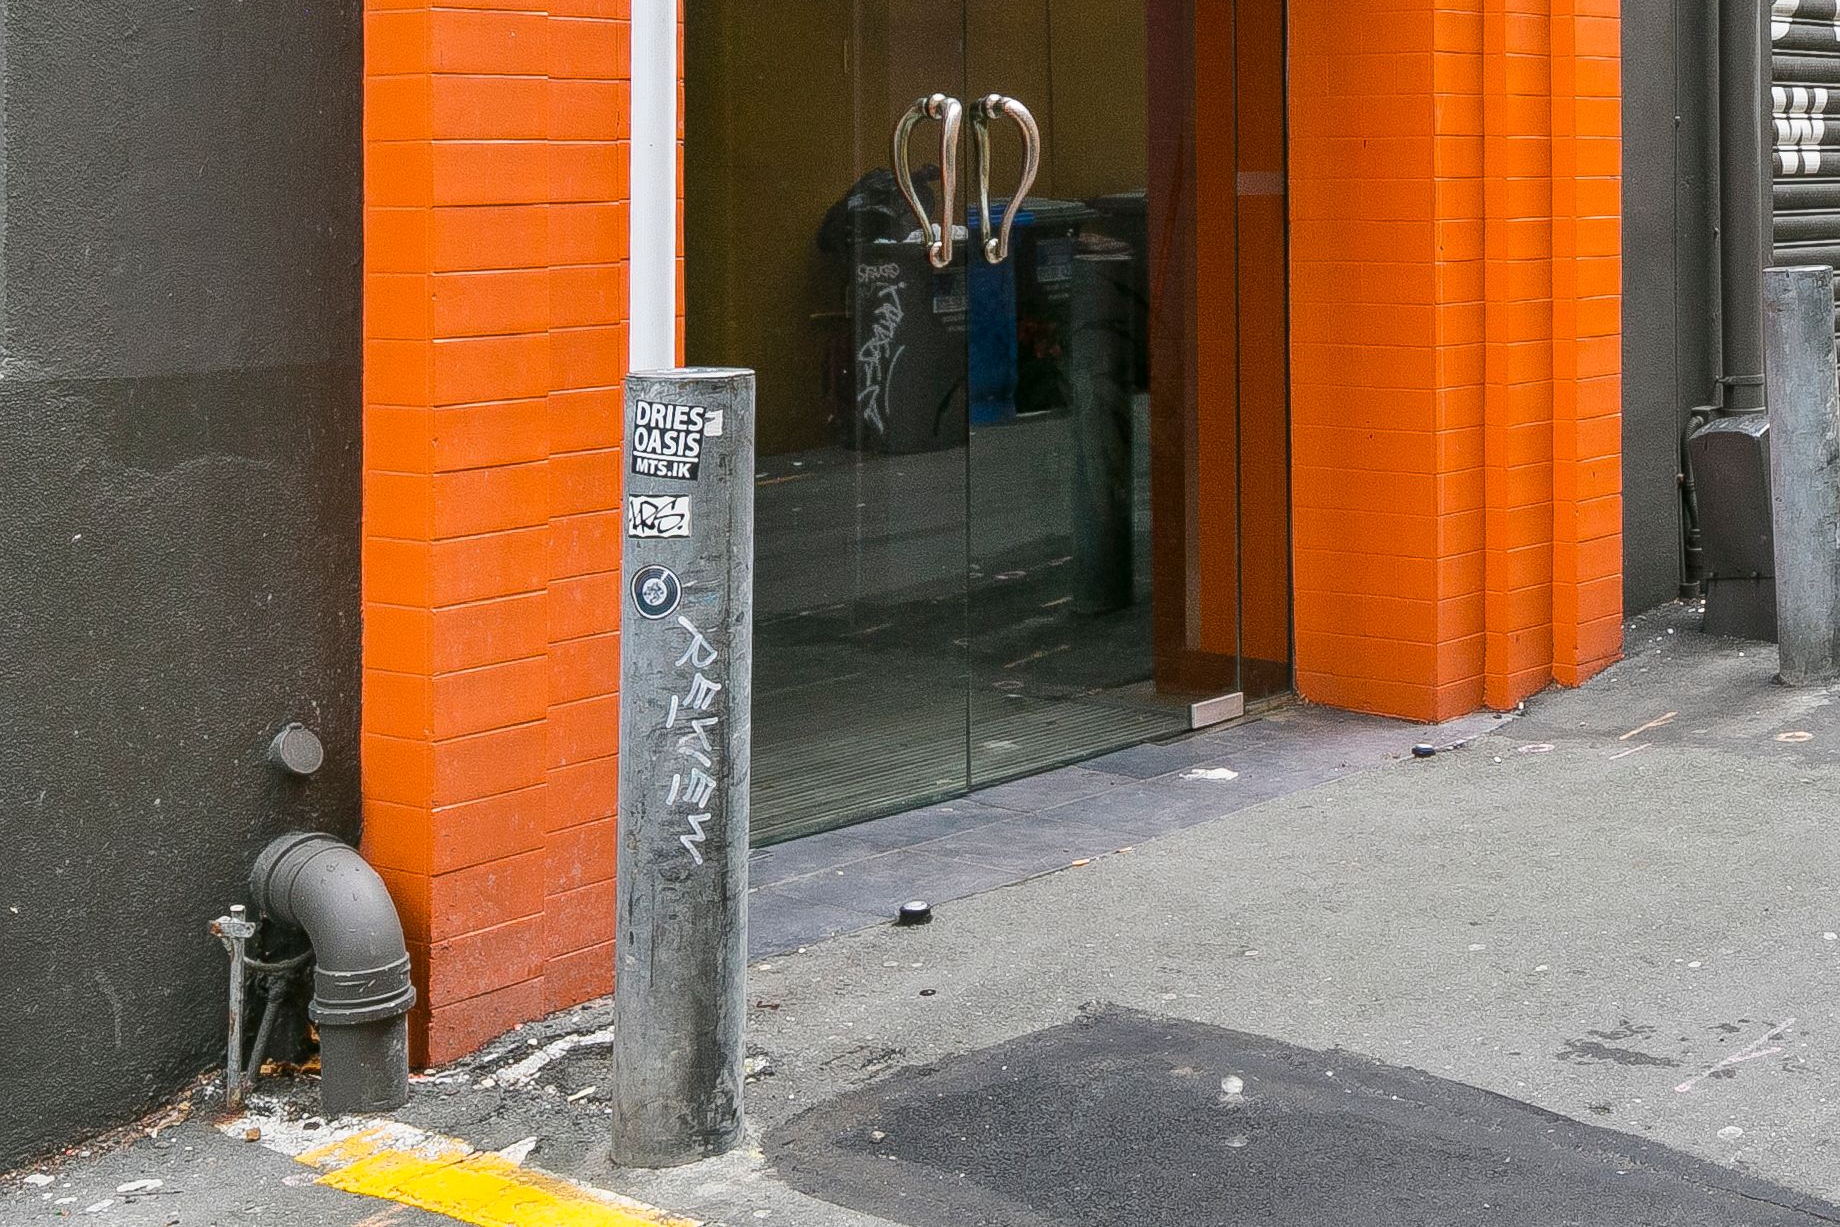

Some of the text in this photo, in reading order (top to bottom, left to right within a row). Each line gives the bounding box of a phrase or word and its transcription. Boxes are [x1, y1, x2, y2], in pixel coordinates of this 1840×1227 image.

[636, 400, 705, 432] DRIES
[633, 426, 702, 458] OASIS
[635, 458, 692, 479] MTS.IK
